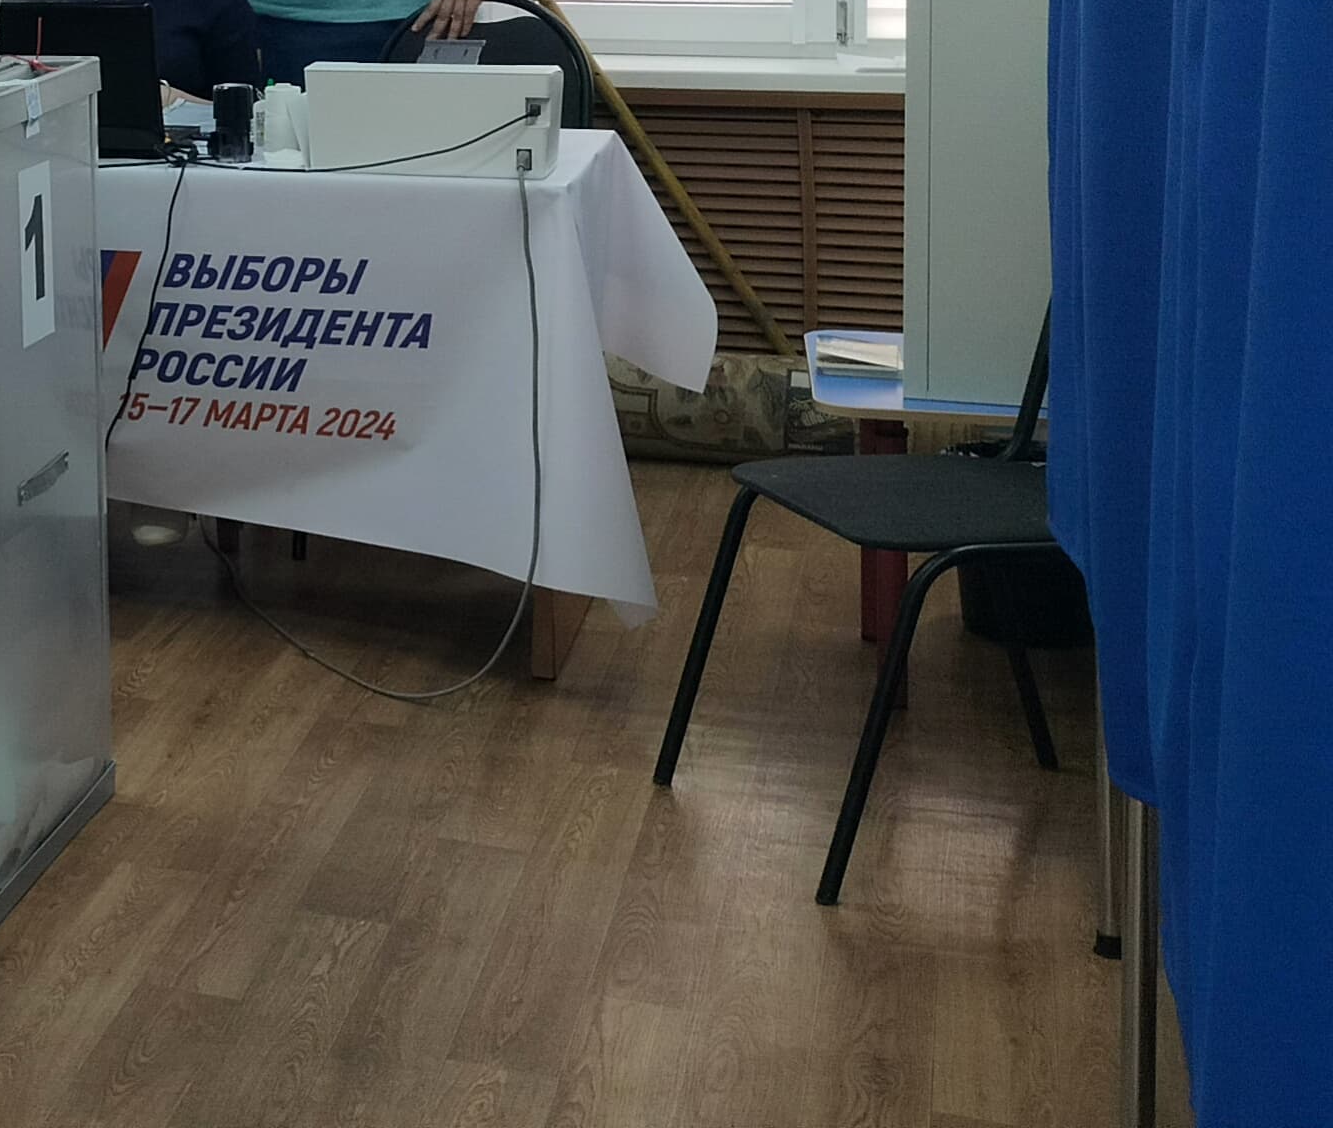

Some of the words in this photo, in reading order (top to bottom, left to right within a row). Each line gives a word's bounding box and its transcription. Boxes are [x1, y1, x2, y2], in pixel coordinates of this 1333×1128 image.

[24, 193, 46, 301] 1
[162, 253, 369, 295] ВЫБОРЫ
[146, 301, 433, 350] ПРЕЗИДЕНТА
[130, 348, 308, 393] РОССИИ
[202, 399, 310, 435] МАРТА
[316, 407, 396, 441] 2024
